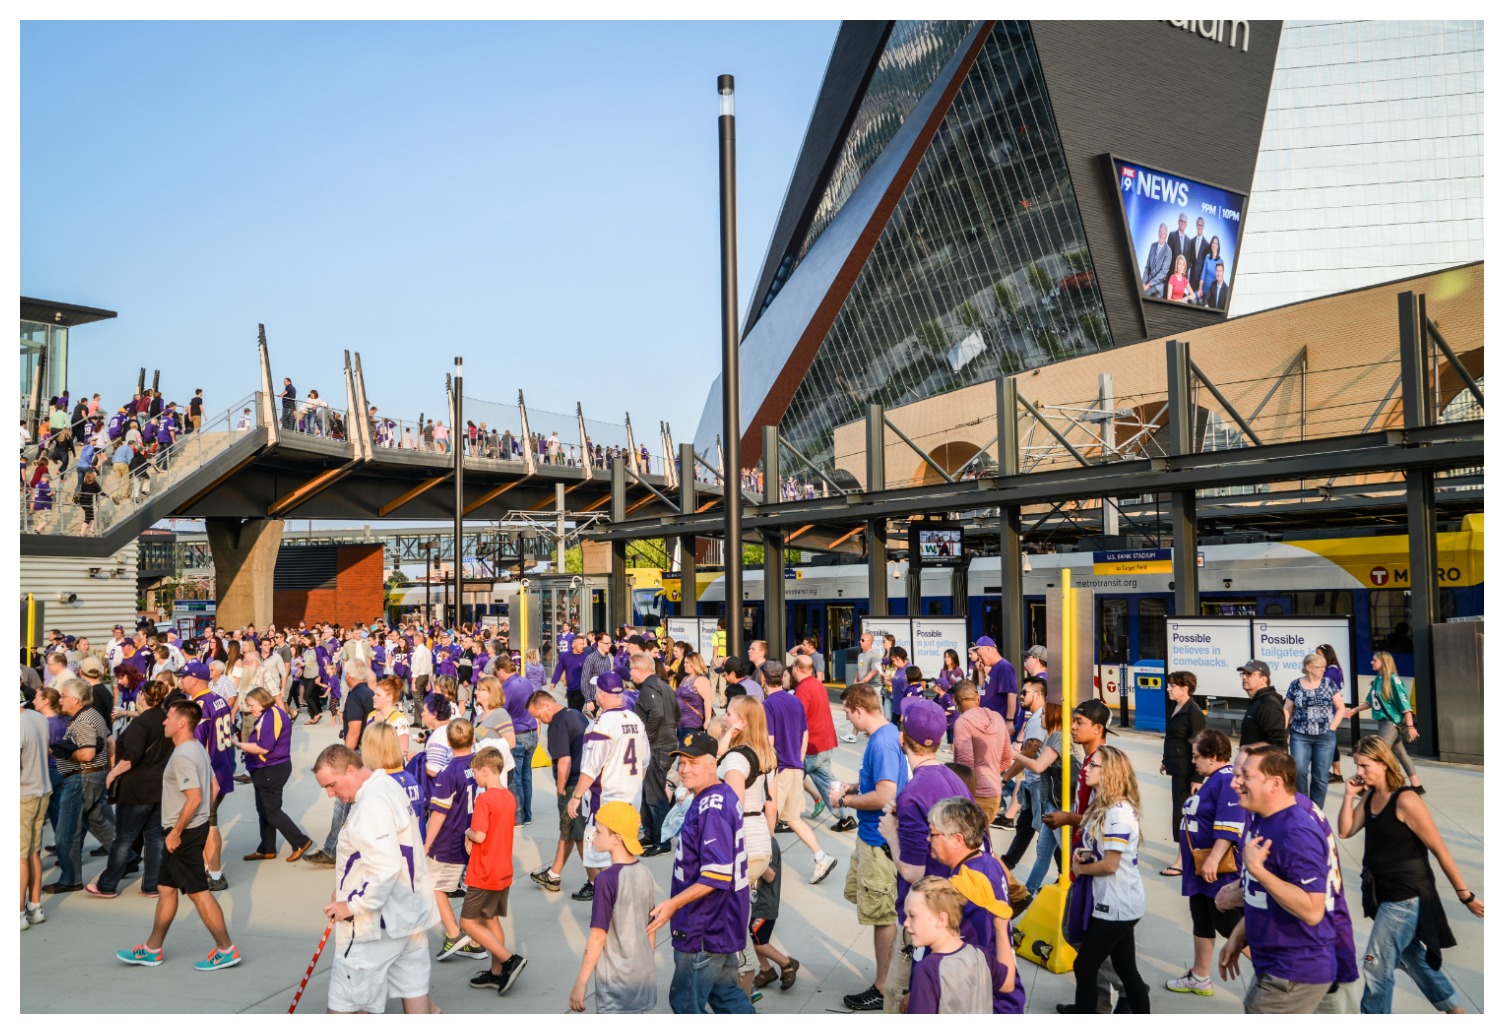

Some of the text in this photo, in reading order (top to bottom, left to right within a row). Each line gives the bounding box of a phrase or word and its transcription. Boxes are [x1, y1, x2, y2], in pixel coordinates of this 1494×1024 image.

[1123, 178, 1133, 191] 9
[1136, 170, 1190, 208] NEWS
[1201, 202, 1240, 222] 9PM 10PM
[1132, 552, 1156, 560] STADIUM
[1394, 567, 1461, 582] MRO
[1075, 578, 1138, 588] metrotransit.org
[916, 629, 942, 638] Possible
[1172, 632, 1211, 643] Possible
[917, 639, 958, 649] is just getting
[1260, 634, 1305, 645] Possible
[917, 648, 940, 657] started.
[1173, 644, 1221, 654] believes in
[1261, 647, 1306, 659] tailgates
[1173, 657, 1229, 668] comebacks.
[215, 713, 232, 752] 69
[623, 737, 638, 776] 4
[698, 794, 724, 813] 22
